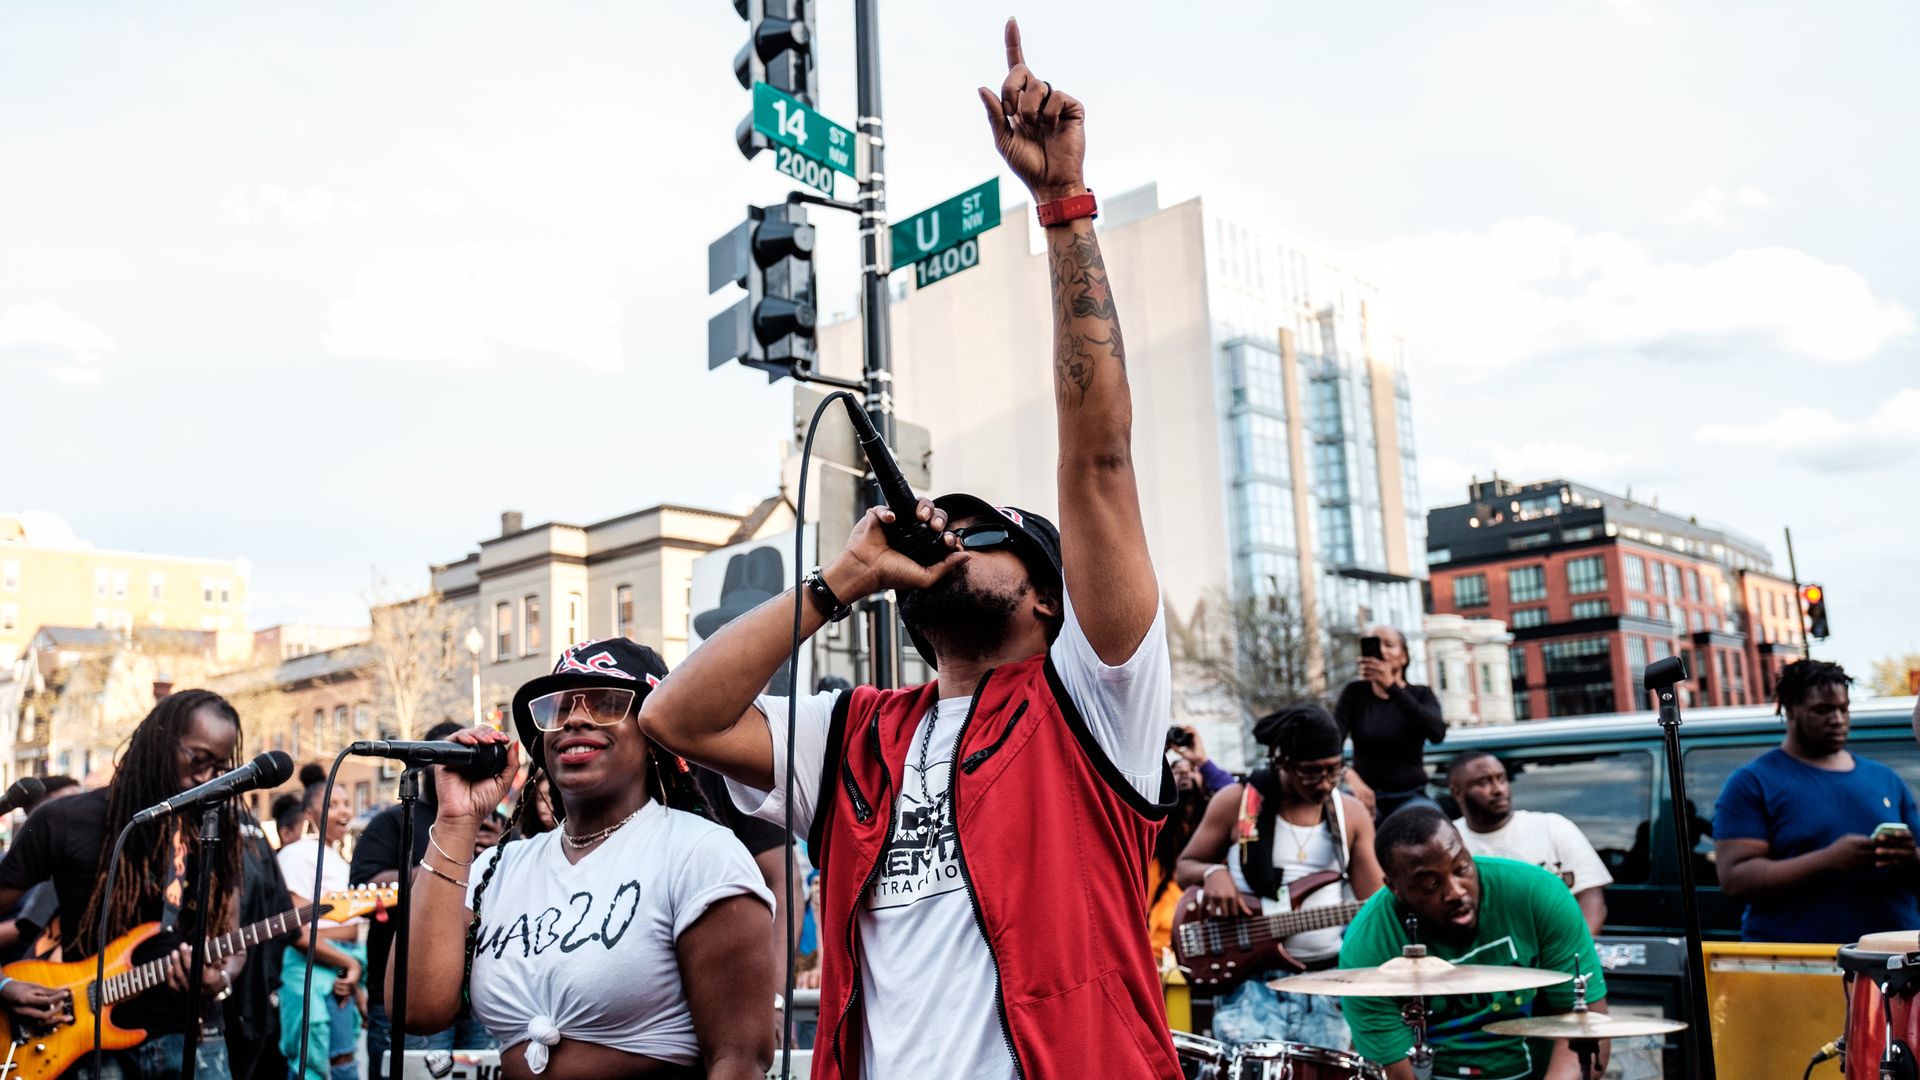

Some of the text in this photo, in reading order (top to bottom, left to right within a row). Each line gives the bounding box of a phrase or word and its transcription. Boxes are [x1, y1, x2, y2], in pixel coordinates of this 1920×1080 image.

[772, 99, 847, 147] 14 ST
[778, 146, 833, 194] 2000
[829, 145, 849, 167] NW
[916, 191, 982, 252] U ST
[962, 208, 985, 233] NW
[917, 240, 978, 285] 1400
